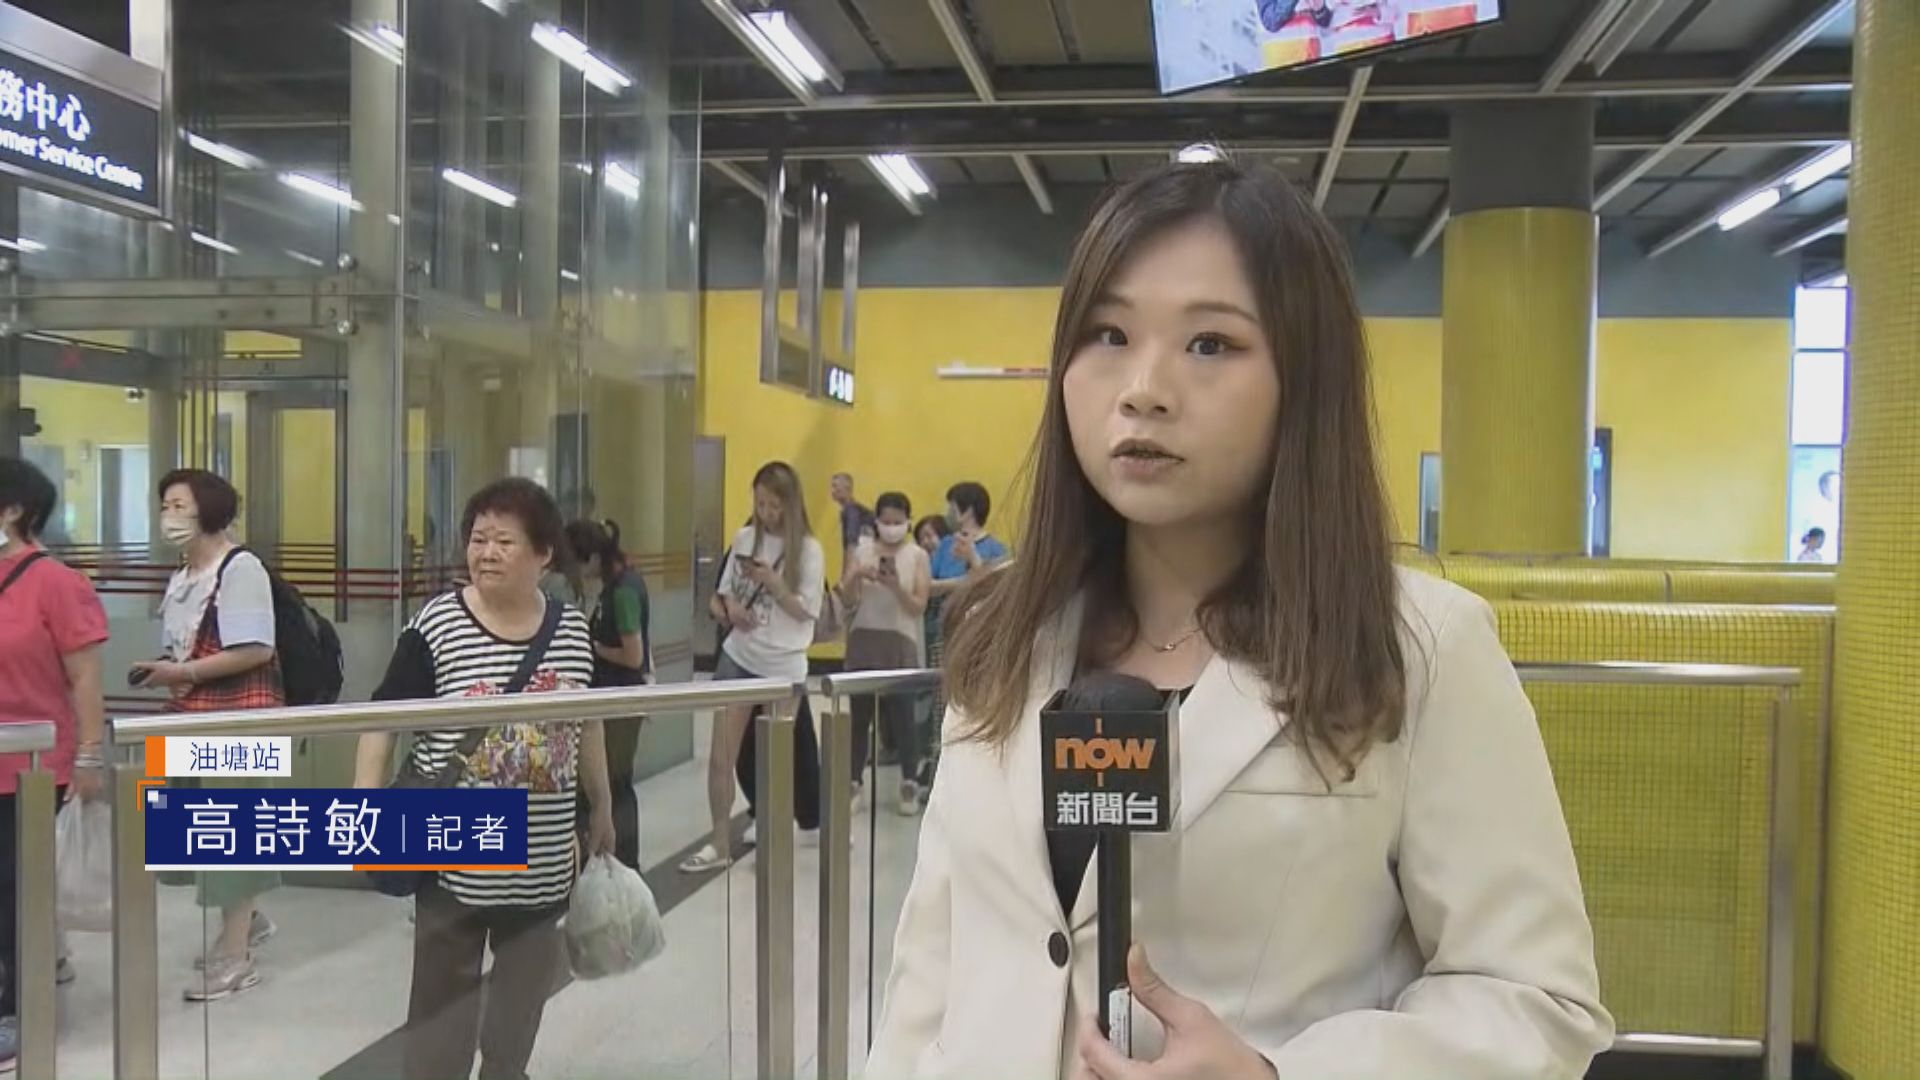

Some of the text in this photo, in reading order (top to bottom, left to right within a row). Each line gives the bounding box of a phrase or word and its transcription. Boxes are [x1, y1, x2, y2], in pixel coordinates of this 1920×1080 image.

[39, 136, 95, 175] Service
[94, 155, 143, 191] Centre
[1055, 737, 1157, 770] now
[1056, 791, 1159, 826] 新聞台
